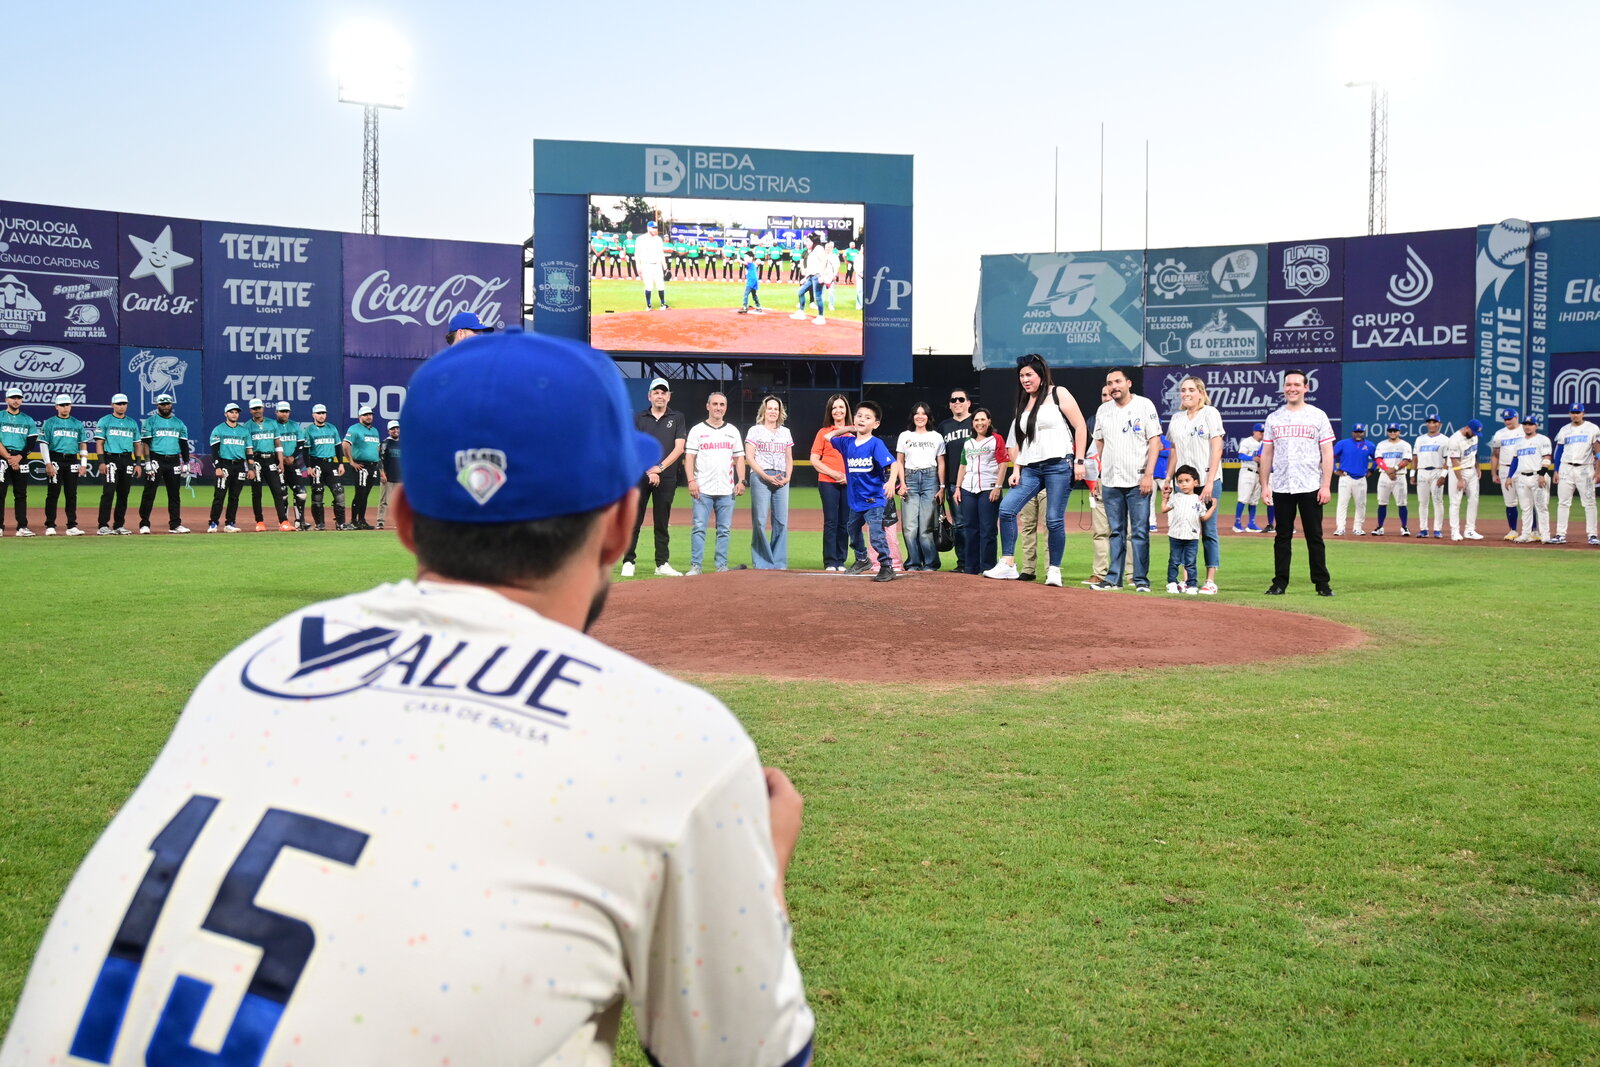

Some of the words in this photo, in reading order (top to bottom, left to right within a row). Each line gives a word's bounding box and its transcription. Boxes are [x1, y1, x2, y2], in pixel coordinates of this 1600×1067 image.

[695, 152, 755, 170] BEDA
[695, 173, 811, 194] INDUSTRIAS
[5, 217, 78, 235] UROLOGIA
[803, 220, 825, 228] FUEL
[827, 221, 852, 229] STOP
[9, 232, 92, 249] AVANZADA
[219, 233, 310, 263] TECATE
[43, 256, 100, 269] CARDENAS
[1287, 247, 1327, 264] LMB
[1287, 264, 1328, 287] 100
[53, 283, 91, 295] Somos
[75, 287, 113, 301] Carne!
[223, 279, 312, 307] TECATE
[351, 269, 511, 327] Coca-Cola
[1533, 251, 1549, 330] RESULTADO
[122, 292, 170, 312] Carl's
[170, 296, 195, 315] Jr.
[1023, 309, 1051, 318] AÑOS
[1352, 312, 1415, 327] GRUPO
[1481, 311, 1493, 325] EL
[1022, 321, 1102, 335] GREENBRIER
[1273, 331, 1335, 342] RYMCO
[1352, 325, 1467, 349] LAZALDE
[223, 326, 311, 353] TECATE
[1066, 334, 1100, 343] GIMSA
[1190, 339, 1203, 349] EL
[1206, 337, 1255, 348] OFERTON
[1533, 335, 1546, 354] ES
[13, 350, 65, 372] Ford
[1223, 349, 1256, 357] CARNES
[1207, 370, 1277, 385] HARINA
[1275, 369, 1319, 394] 16
[1479, 330, 1493, 416] IMPULSANDO
[0, 381, 87, 393] UTOMOTRIZ
[224, 375, 313, 400] TECATE
[1205, 387, 1278, 407] Miller
[1376, 404, 1438, 420] PASEO
[283, 616, 602, 718] VALUE
[404, 700, 451, 714] CASA
[456, 706, 482, 723] DE
[488, 715, 550, 745] BOLSA
[68, 794, 371, 1067] 15
